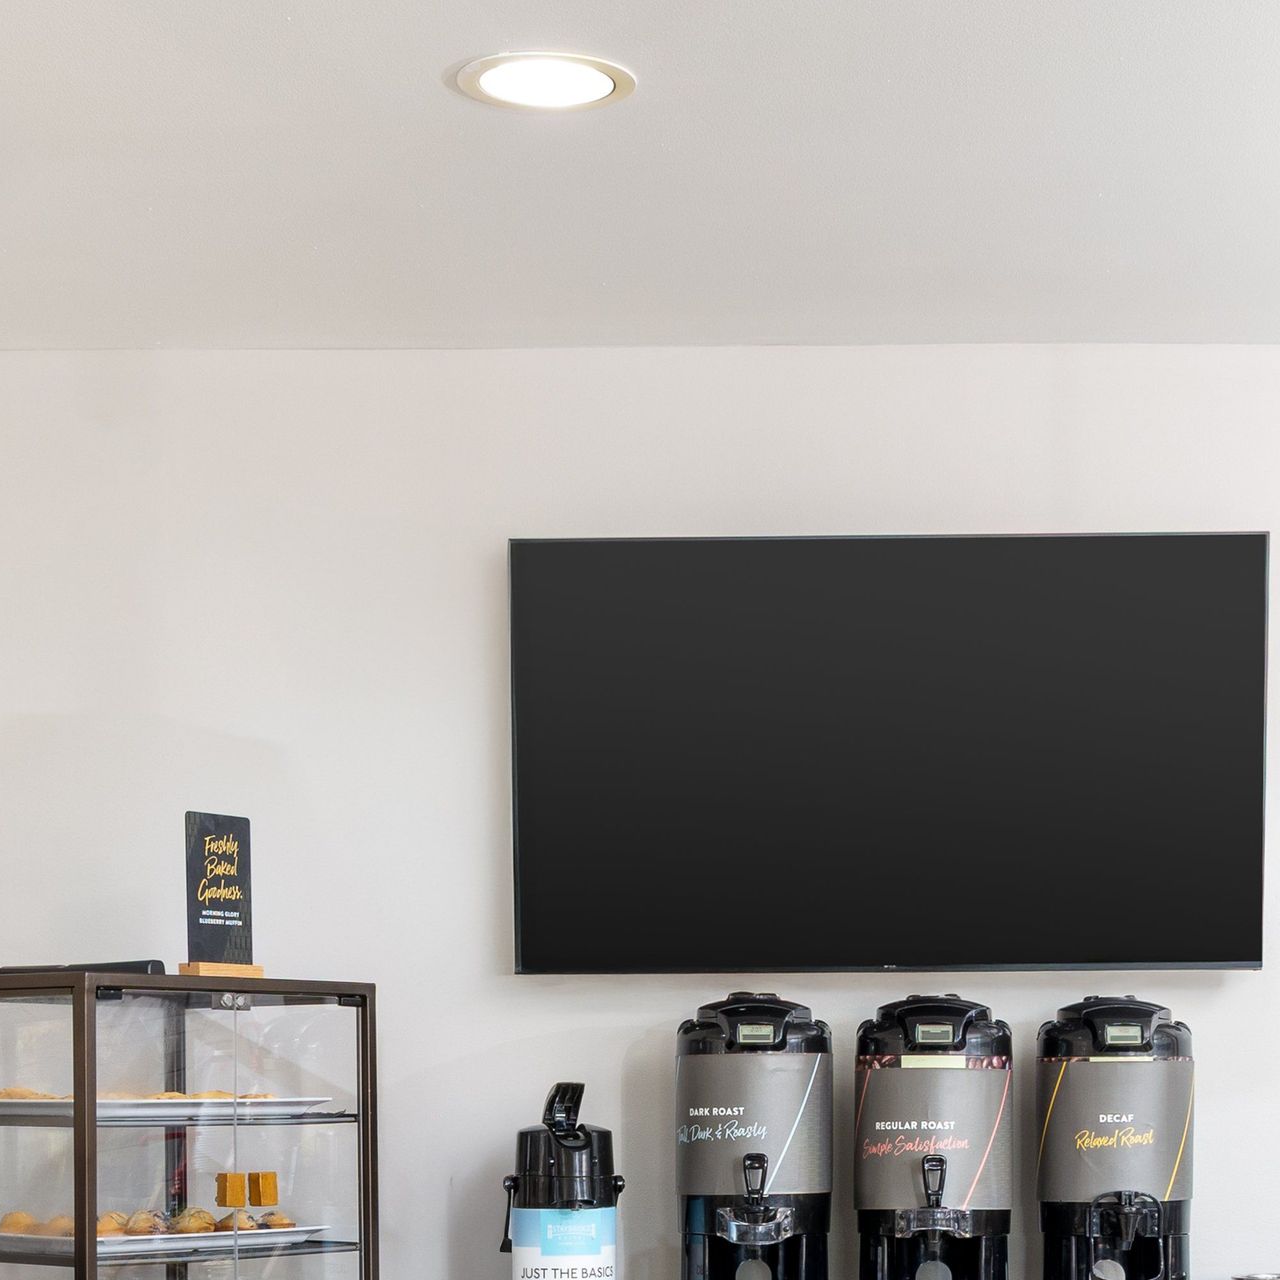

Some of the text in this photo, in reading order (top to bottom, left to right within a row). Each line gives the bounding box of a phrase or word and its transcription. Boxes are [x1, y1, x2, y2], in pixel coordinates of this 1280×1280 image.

[204, 833, 239, 858] Freshly
[204, 856, 238, 879] Baked
[689, 1106, 745, 1116] DARK ROAST
[1099, 1114, 1134, 1123] DECAF
[715, 1123, 723, 1140] &
[723, 1119, 768, 1141] Roasty
[875, 1121, 956, 1130] REGULAR ROAST
[863, 1135, 970, 1159] Simple Satisfaction
[1075, 1126, 1155, 1151] Relaxed Roast
[521, 1265, 614, 1279] JUST THE BASICS
